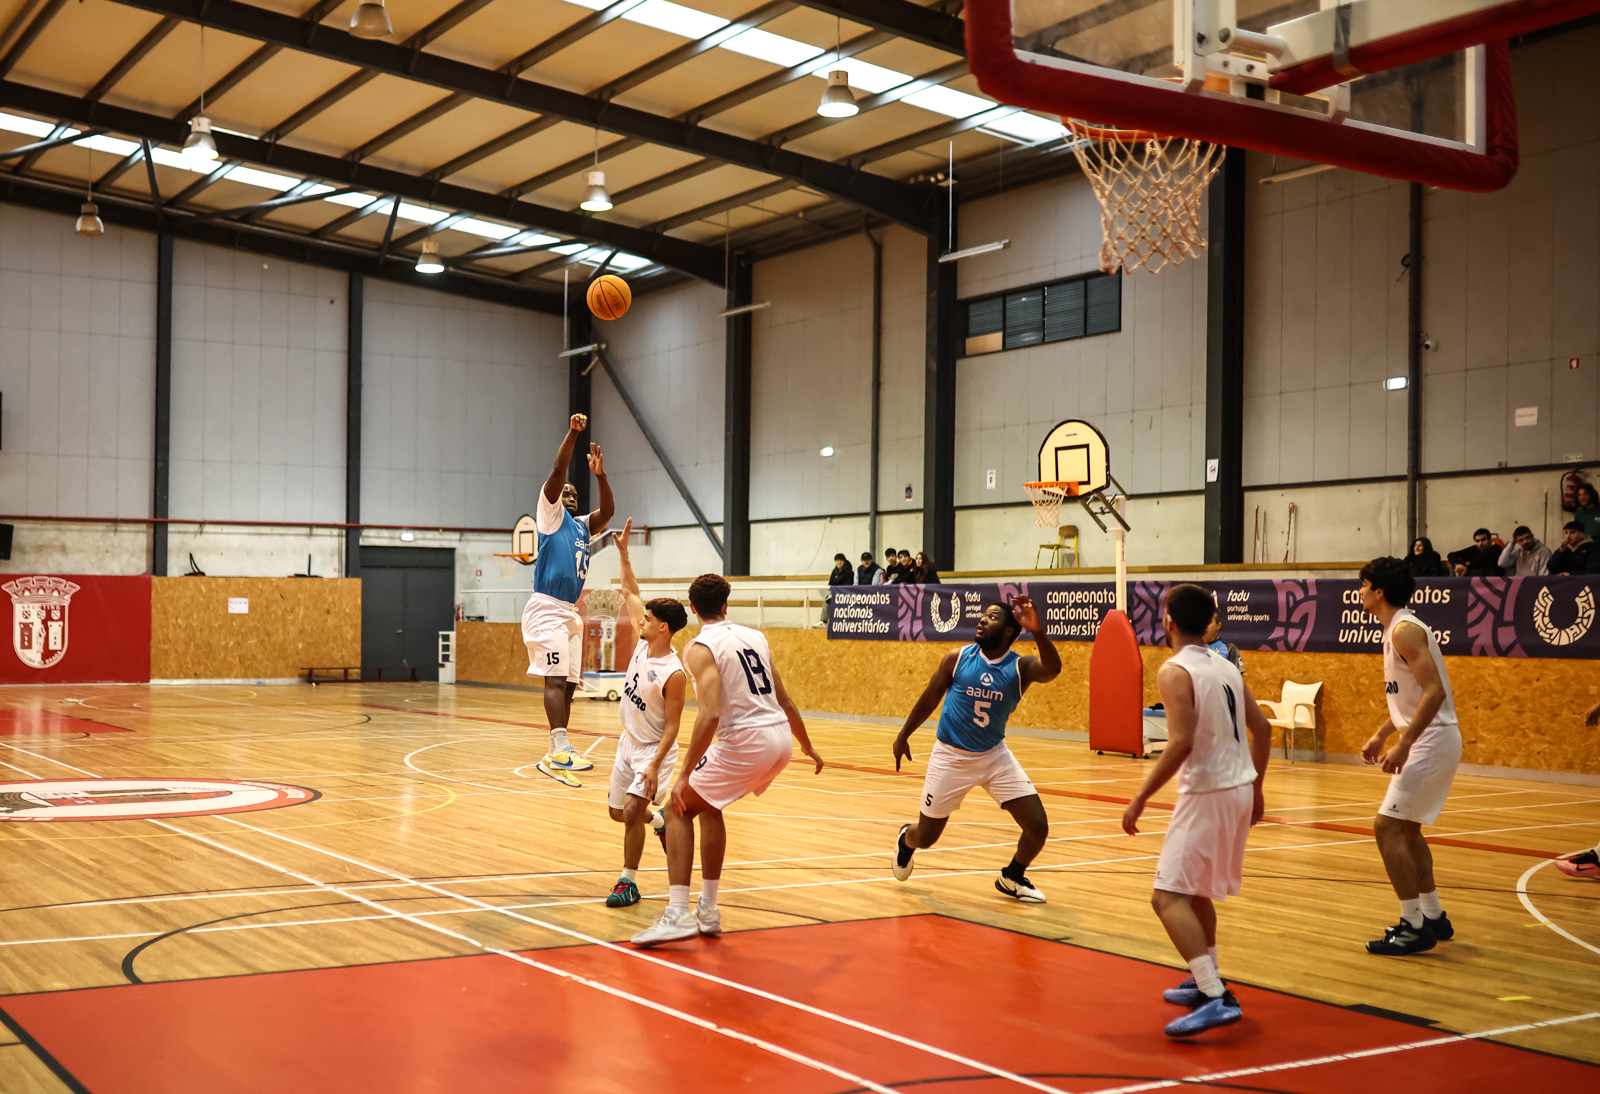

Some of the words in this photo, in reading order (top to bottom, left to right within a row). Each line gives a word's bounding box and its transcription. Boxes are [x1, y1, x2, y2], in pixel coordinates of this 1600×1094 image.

[834, 591, 891, 607] campeonatos
[1046, 588, 1116, 607] campeonato
[1227, 589, 1250, 602] fadu
[833, 605, 874, 619] nacionais
[1046, 604, 1099, 620] nacionais
[1252, 614, 1270, 622] sports
[832, 619, 891, 634] universitários
[1046, 620, 1102, 636] universitá
[546, 652, 560, 666] 15
[965, 686, 1004, 702] aaum
[972, 700, 992, 728] 5
[925, 793, 934, 807] 5
